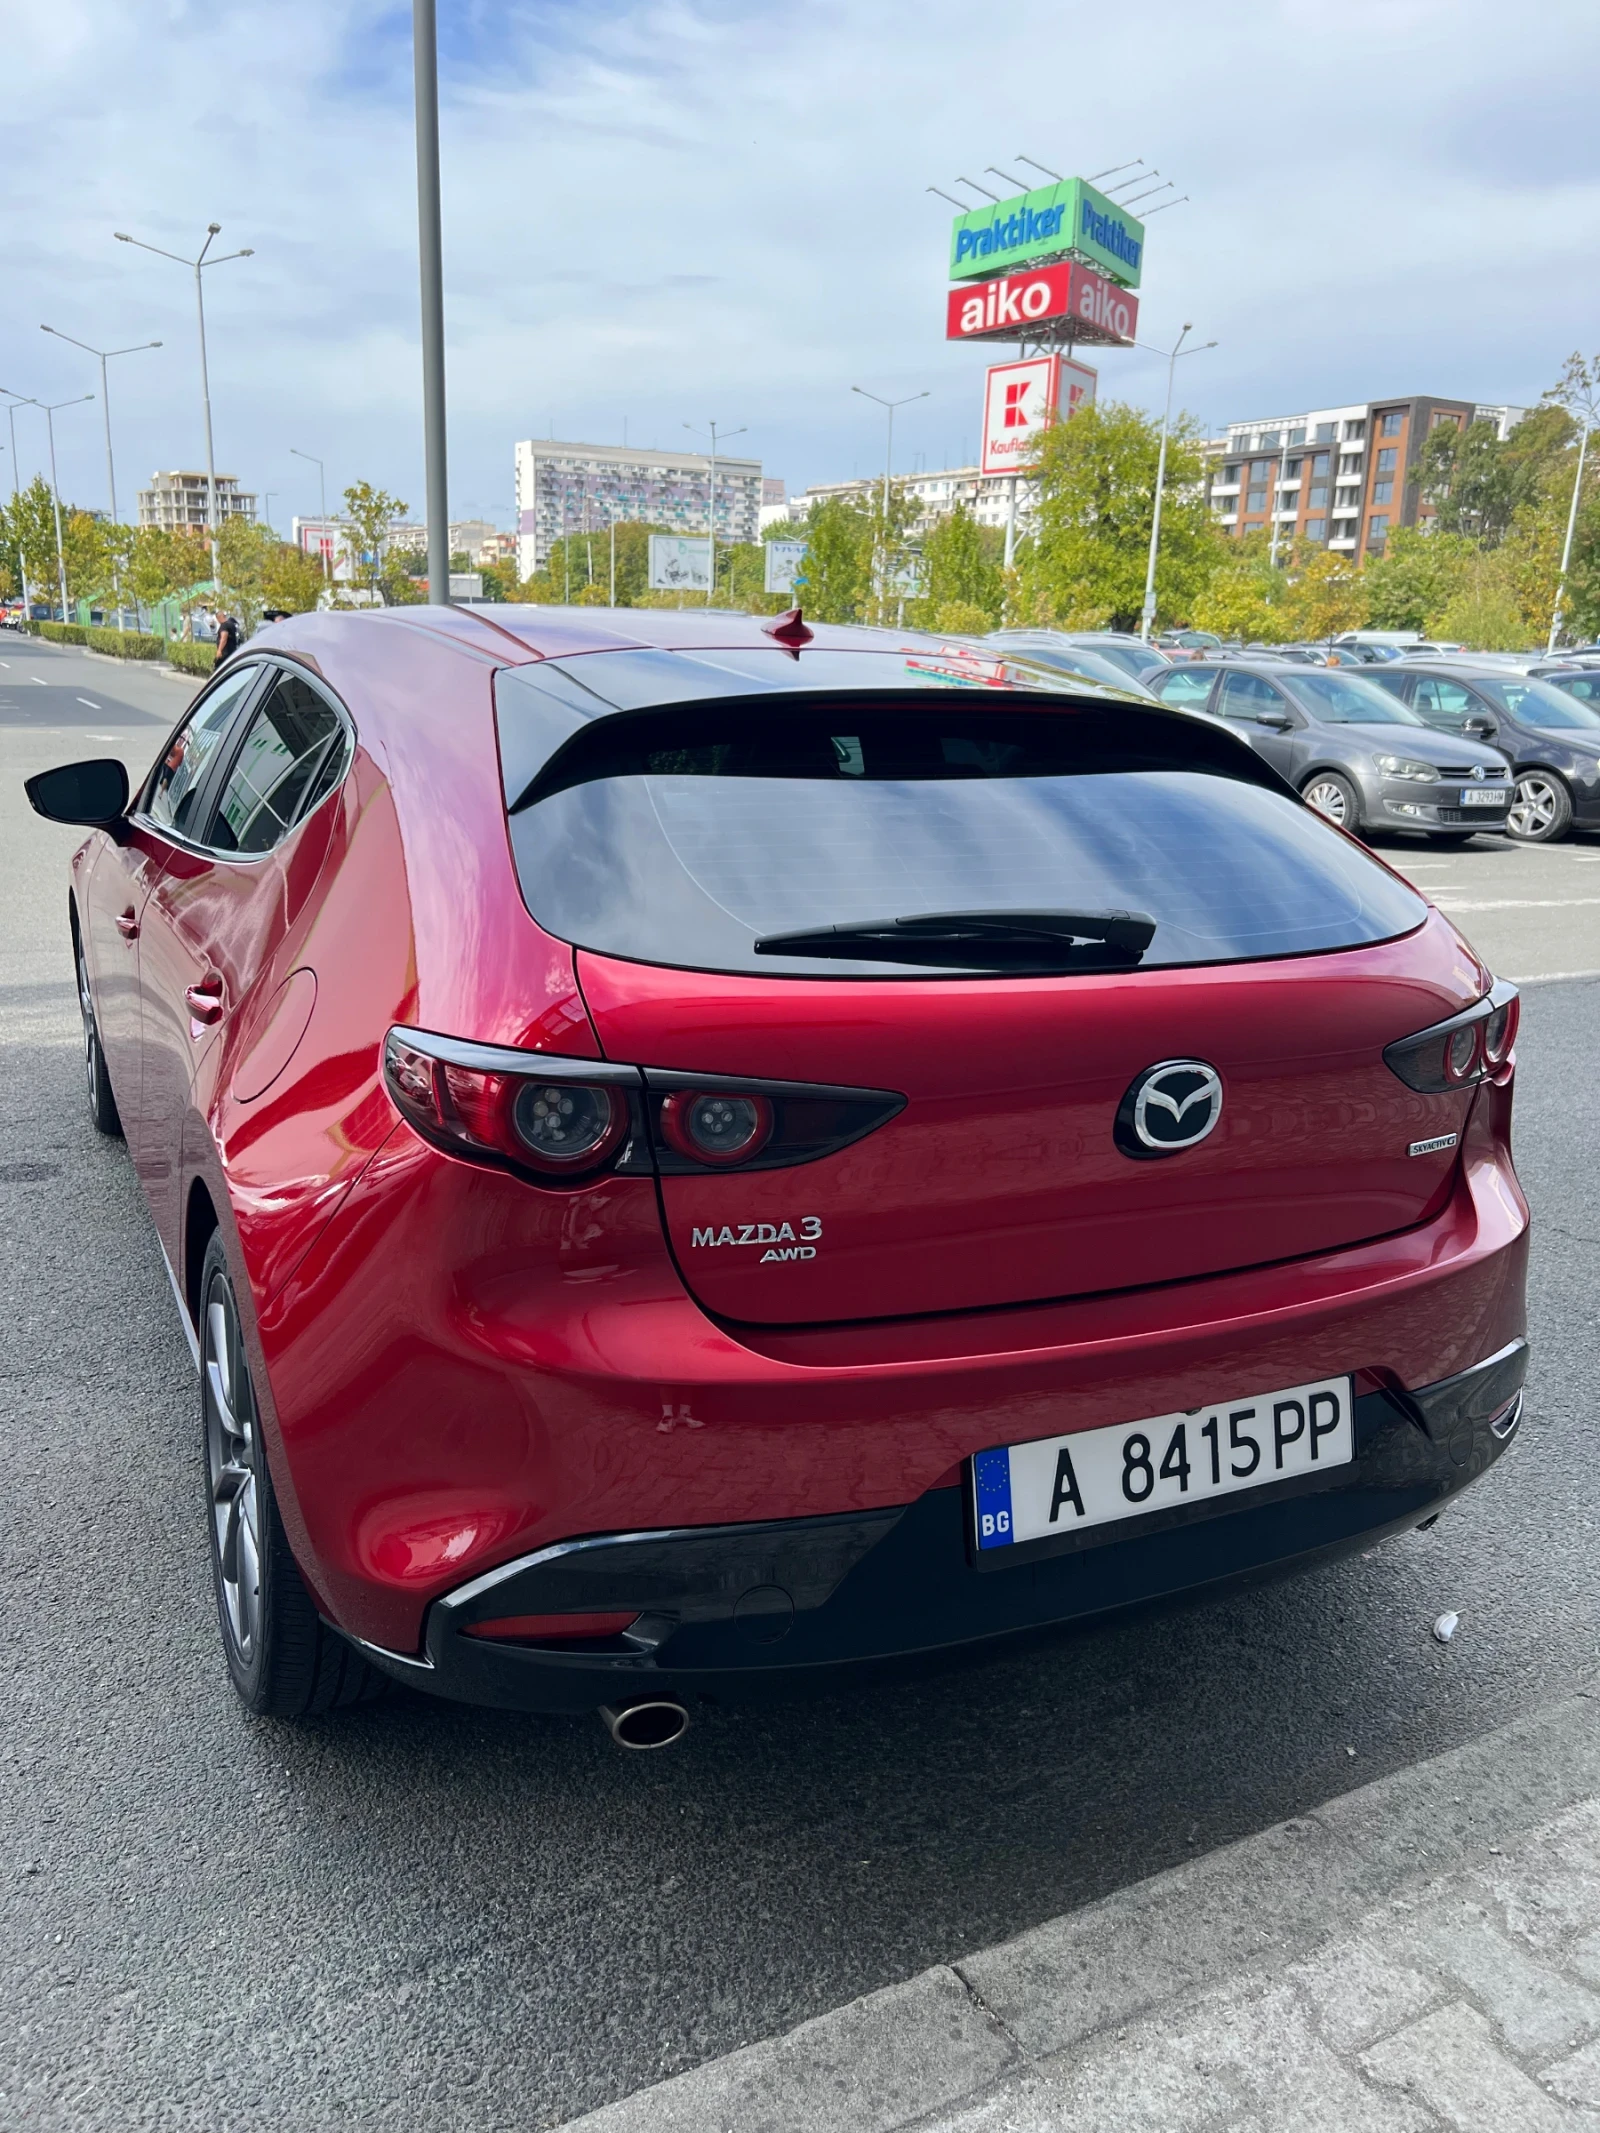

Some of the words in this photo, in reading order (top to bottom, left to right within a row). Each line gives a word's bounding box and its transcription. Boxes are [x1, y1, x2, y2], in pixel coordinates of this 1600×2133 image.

[955, 202, 1066, 263] Praktiker
[1081, 198, 1142, 270] Praktiker
[959, 280, 1052, 332] aiko
[1079, 278, 1130, 337] aiko
[691, 1222, 797, 1248] MAZDA
[799, 1216, 823, 1241] 3
[759, 1246, 817, 1264] AWD
[1048, 1447, 1086, 1523] A
[981, 1510, 1010, 1537] BG
